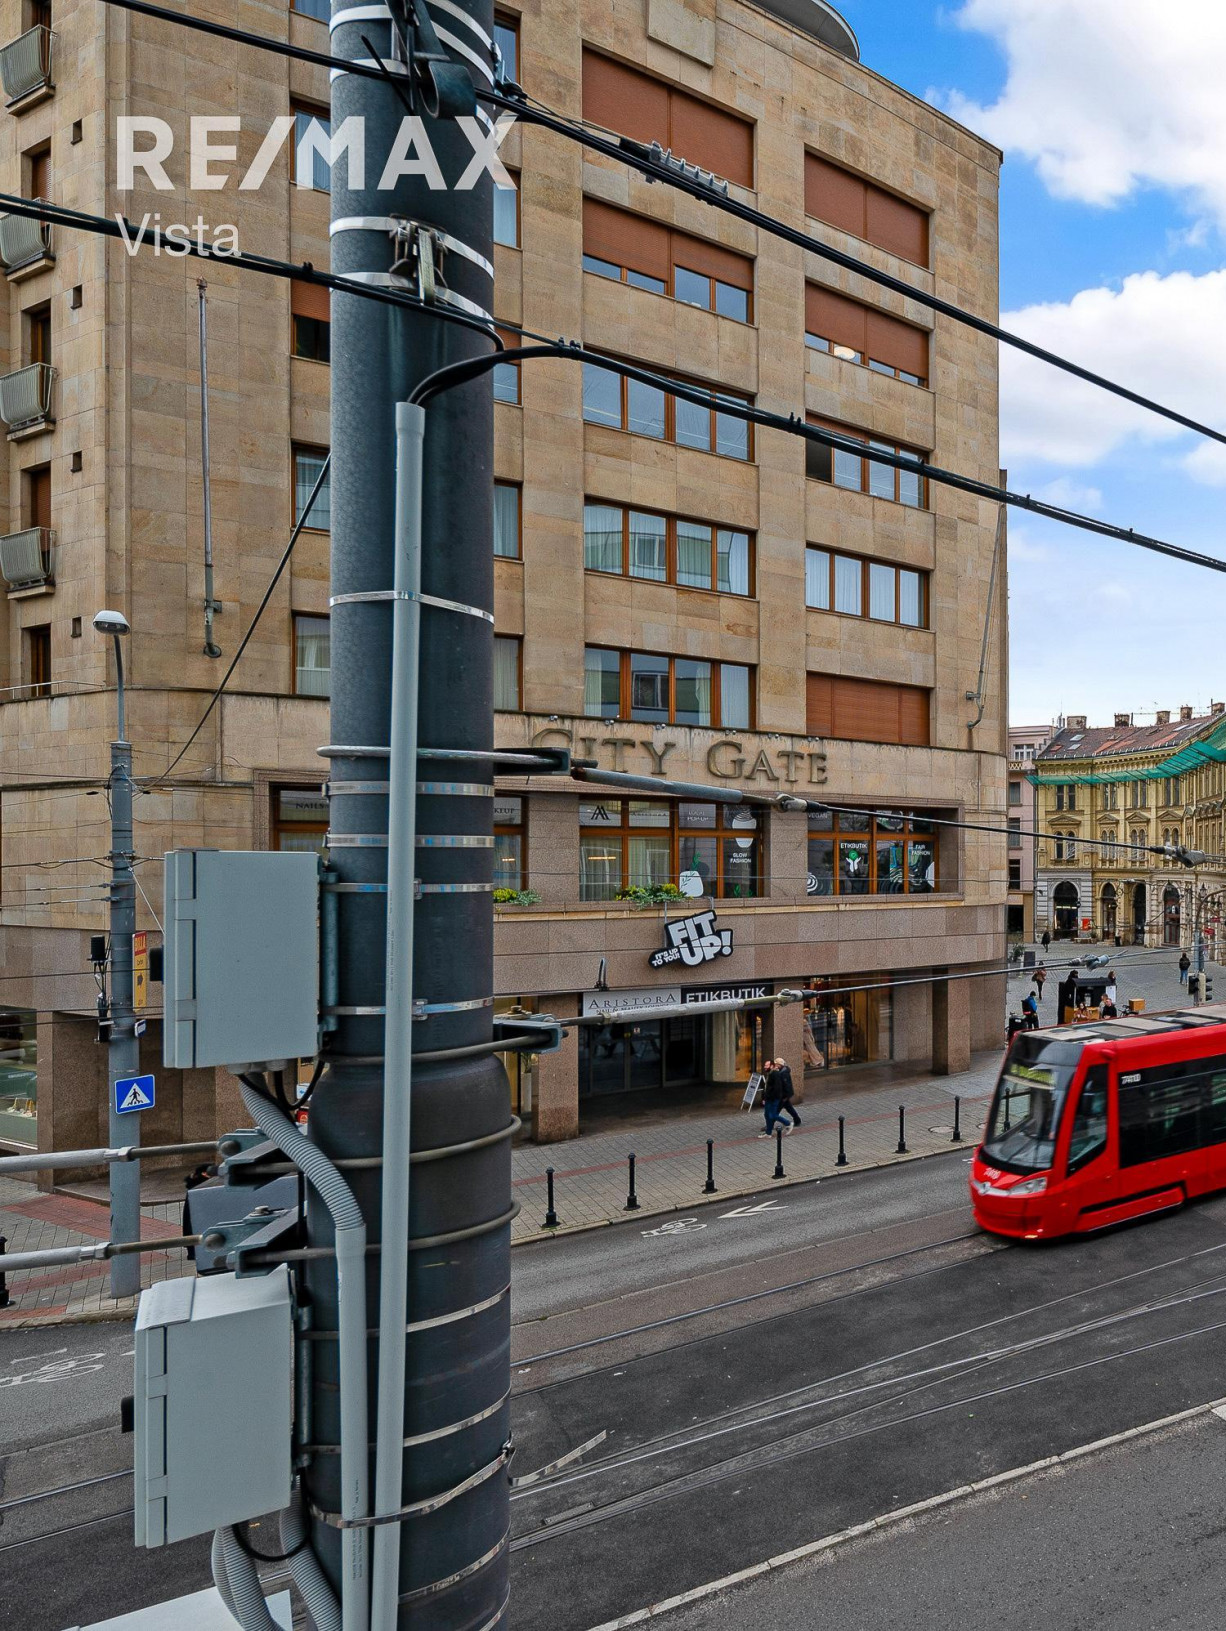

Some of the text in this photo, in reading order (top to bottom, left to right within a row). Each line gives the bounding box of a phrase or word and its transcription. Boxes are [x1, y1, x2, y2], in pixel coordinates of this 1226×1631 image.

[706, 740, 828, 784] GATE
[493, 807, 515, 815] KEUP
[668, 911, 715, 947] FIT
[668, 947, 679, 955] UP
[679, 930, 732, 966] UP!
[651, 959, 664, 967] TO
[589, 986, 766, 1009] ARISTORA ETIKBUTIK
